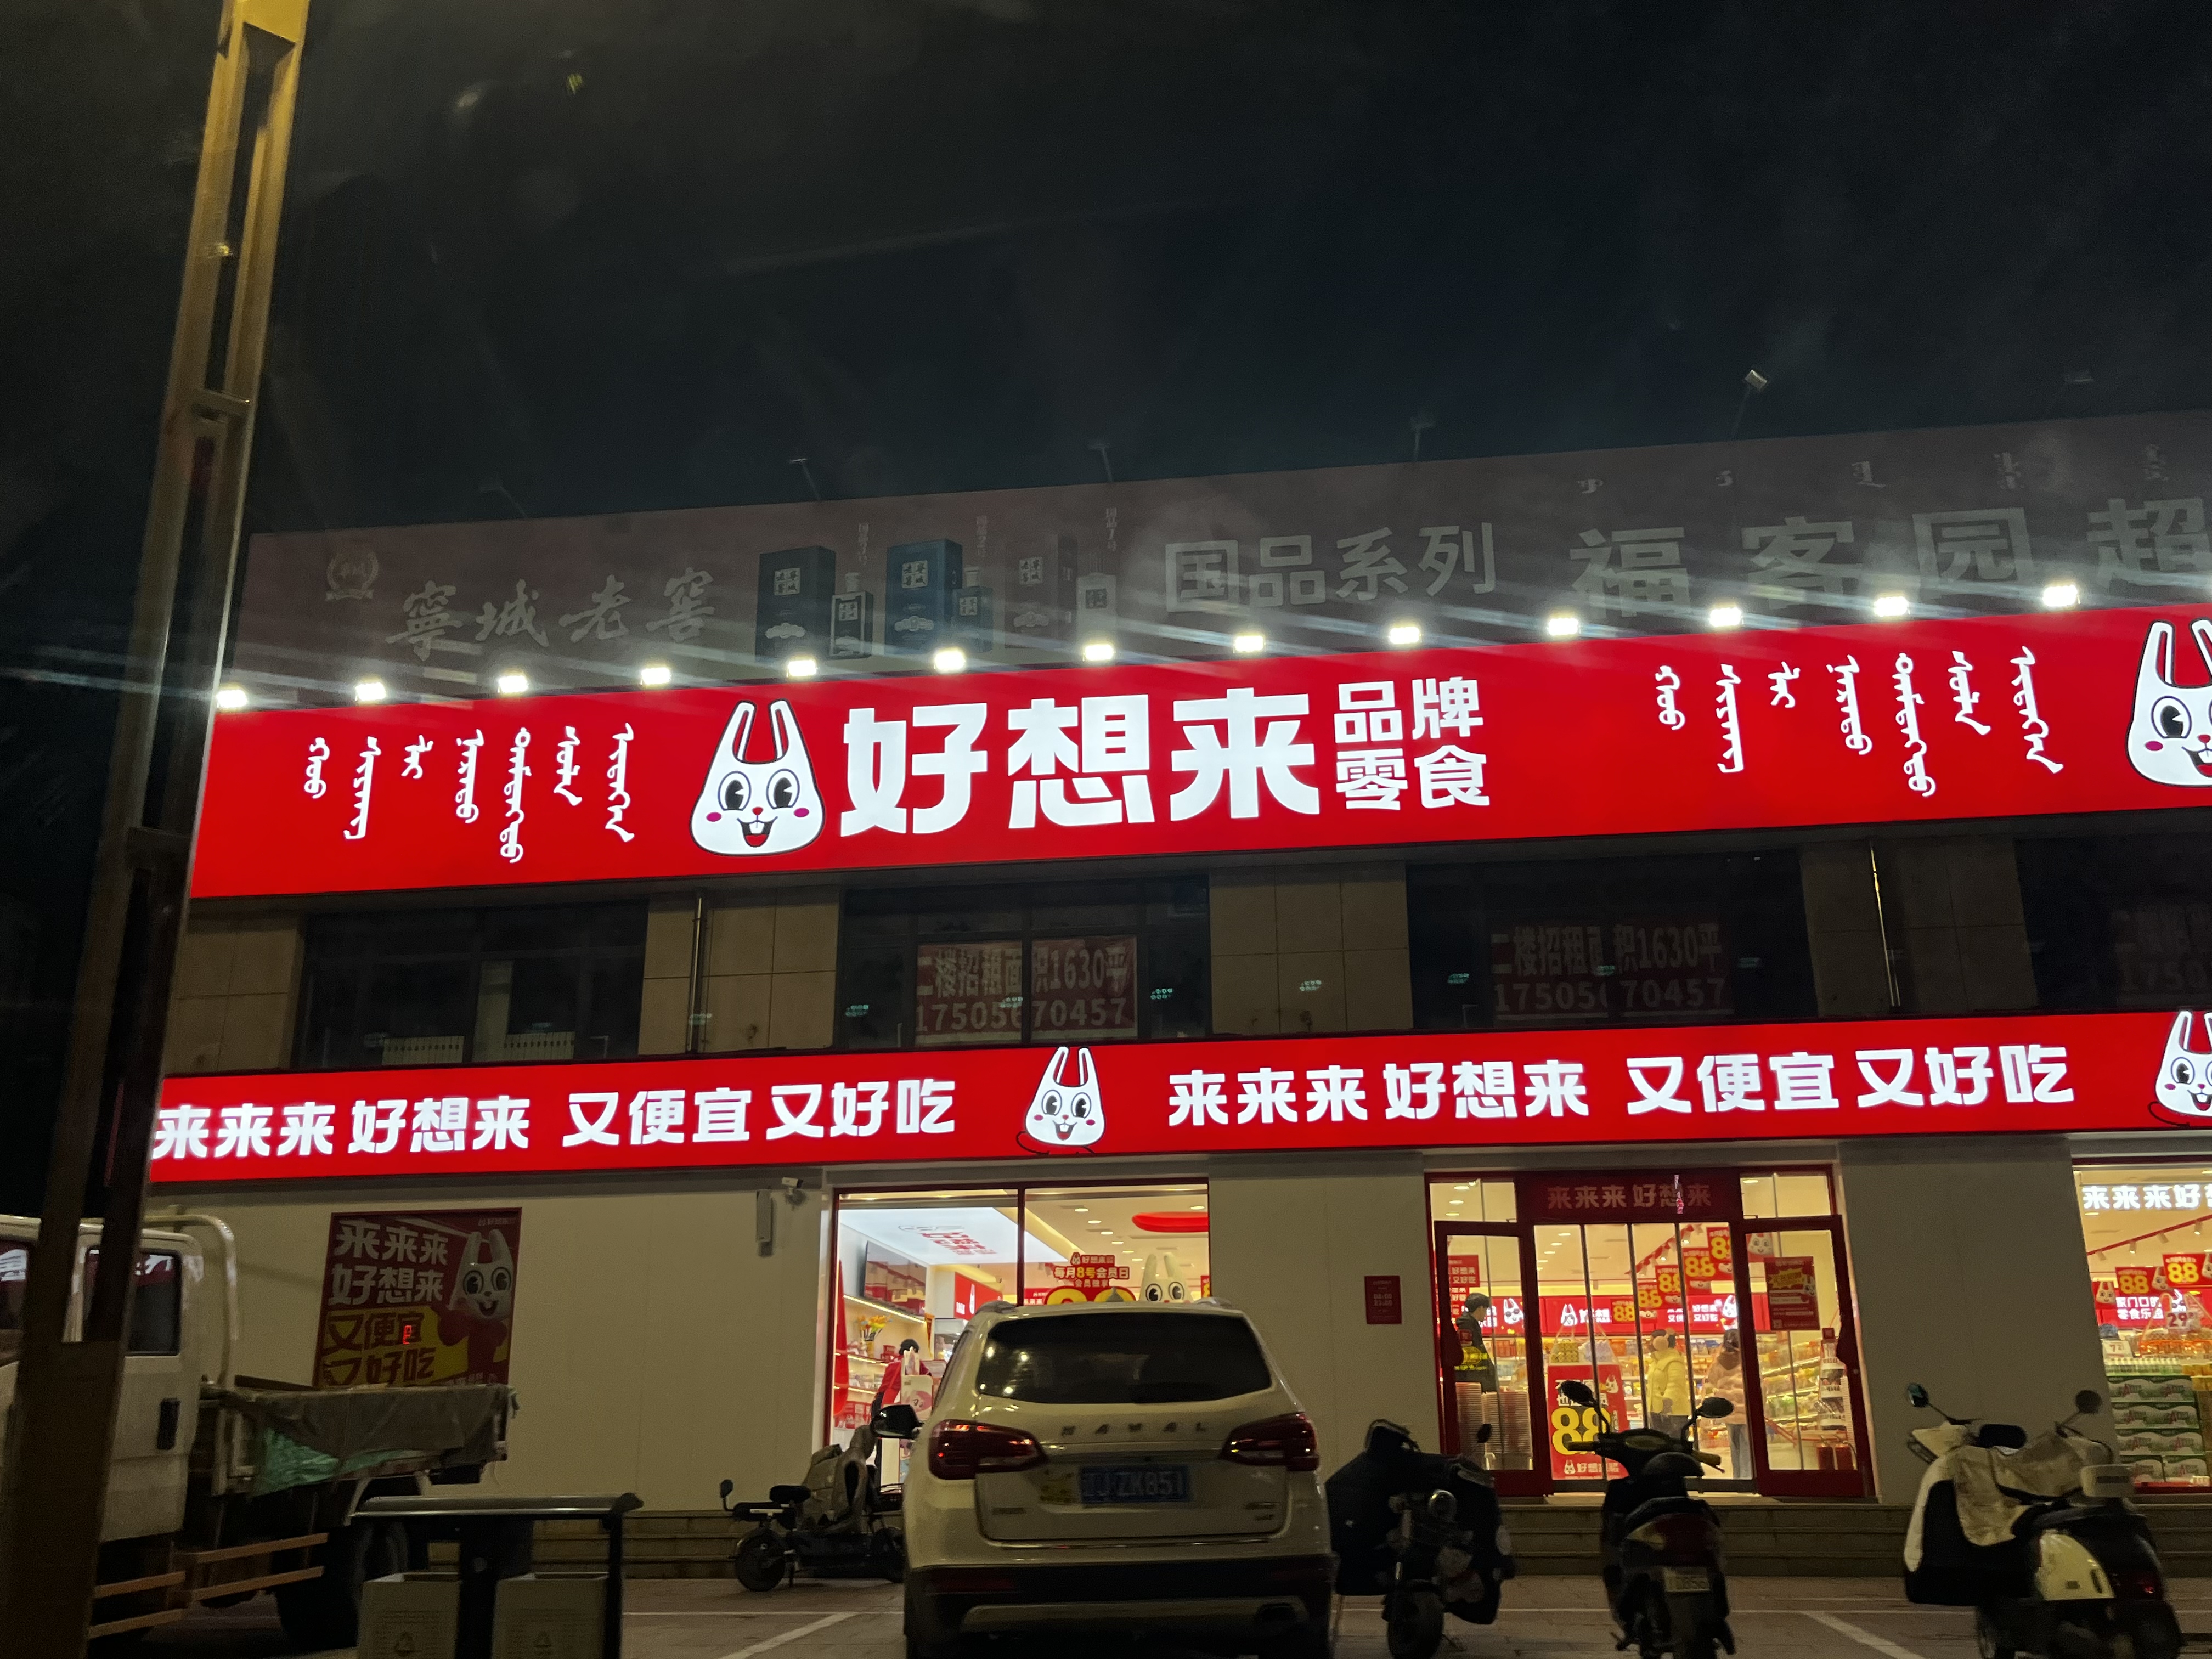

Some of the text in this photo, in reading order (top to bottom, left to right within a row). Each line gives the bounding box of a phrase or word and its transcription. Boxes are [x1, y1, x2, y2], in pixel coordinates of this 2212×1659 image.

[1165, 522, 1496, 613] 国品系列
[1334, 677, 1483, 743] 品牌
[841, 688, 1319, 837] 好想来
[1336, 745, 1489, 810] 零食
[1169, 1065, 1367, 1126] 来来来
[1383, 1060, 1588, 1119] 好想来
[151, 1102, 335, 1159] 来来来
[348, 1096, 529, 1153] 好想来
[1548, 1184, 1711, 1209] 来来来 好想来
[334, 1219, 448, 1265] 来来来
[328, 1263, 443, 1305] 好想来
[1054, 1267, 1129, 1279] 每月8号会员日
[2120, 1275, 2149, 1294] 88
[2168, 1262, 2199, 1283] 88
[323, 1311, 424, 1355] 又便宜
[321, 1347, 437, 1386] 又好吃
